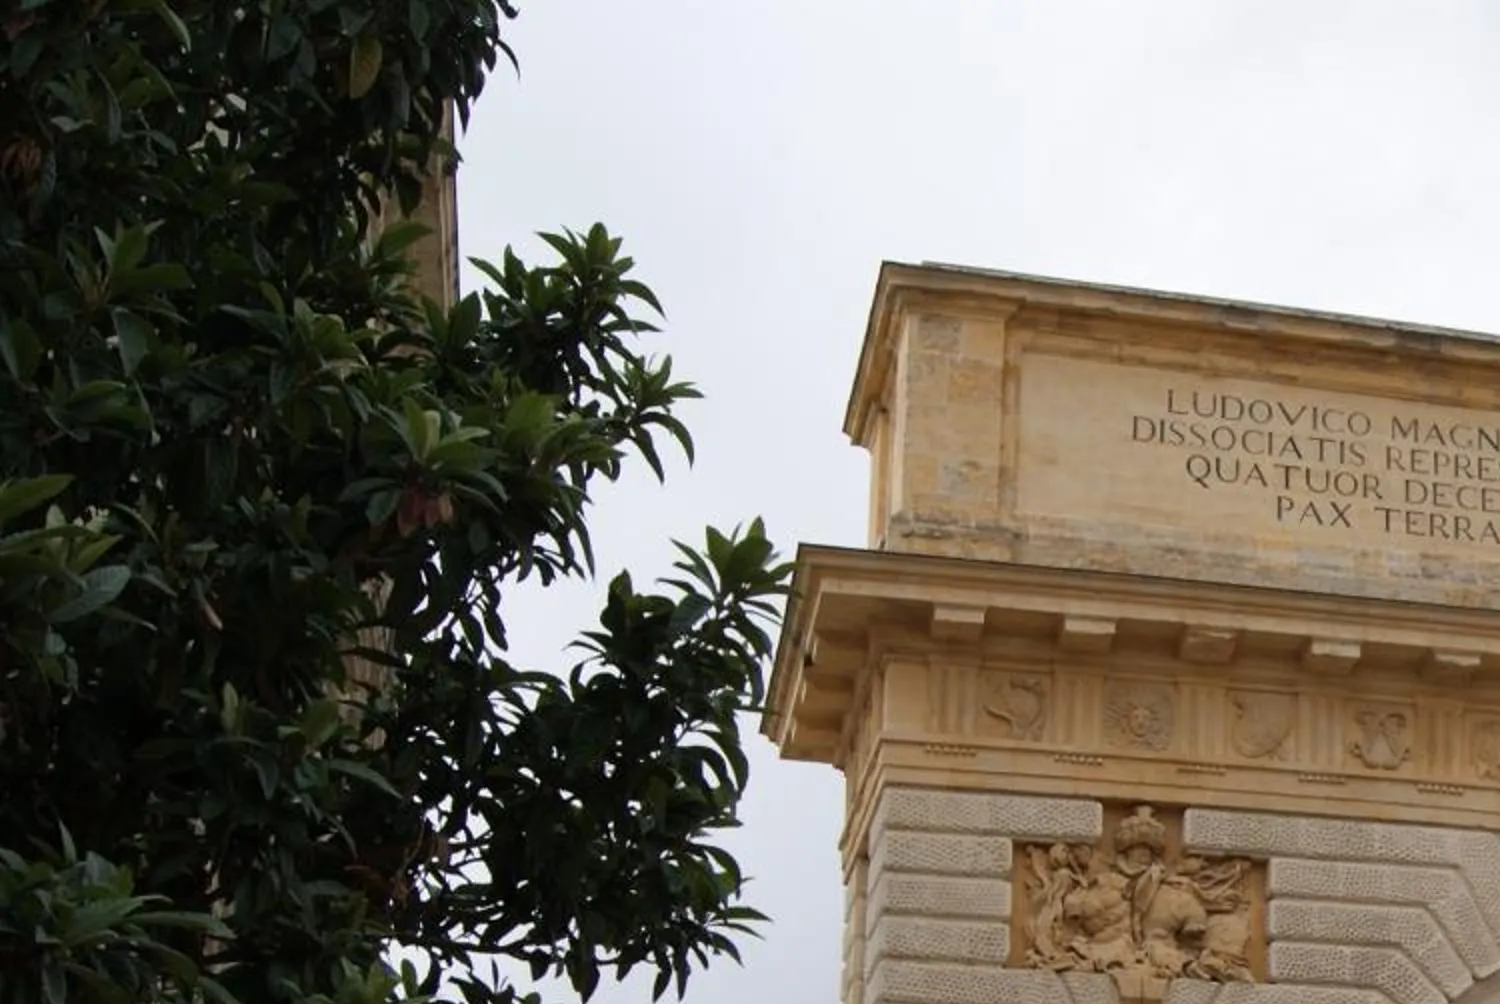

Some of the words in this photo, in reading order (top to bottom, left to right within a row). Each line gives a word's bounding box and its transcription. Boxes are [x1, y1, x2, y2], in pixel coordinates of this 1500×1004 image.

[1167, 389, 1371, 437] LUDOVICO
[1131, 415, 1367, 466] DISSOCIATIS
[1185, 454, 1383, 499] QUATUOR
[1277, 496, 1352, 529] PAX
[1374, 507, 1500, 545] TERRA
